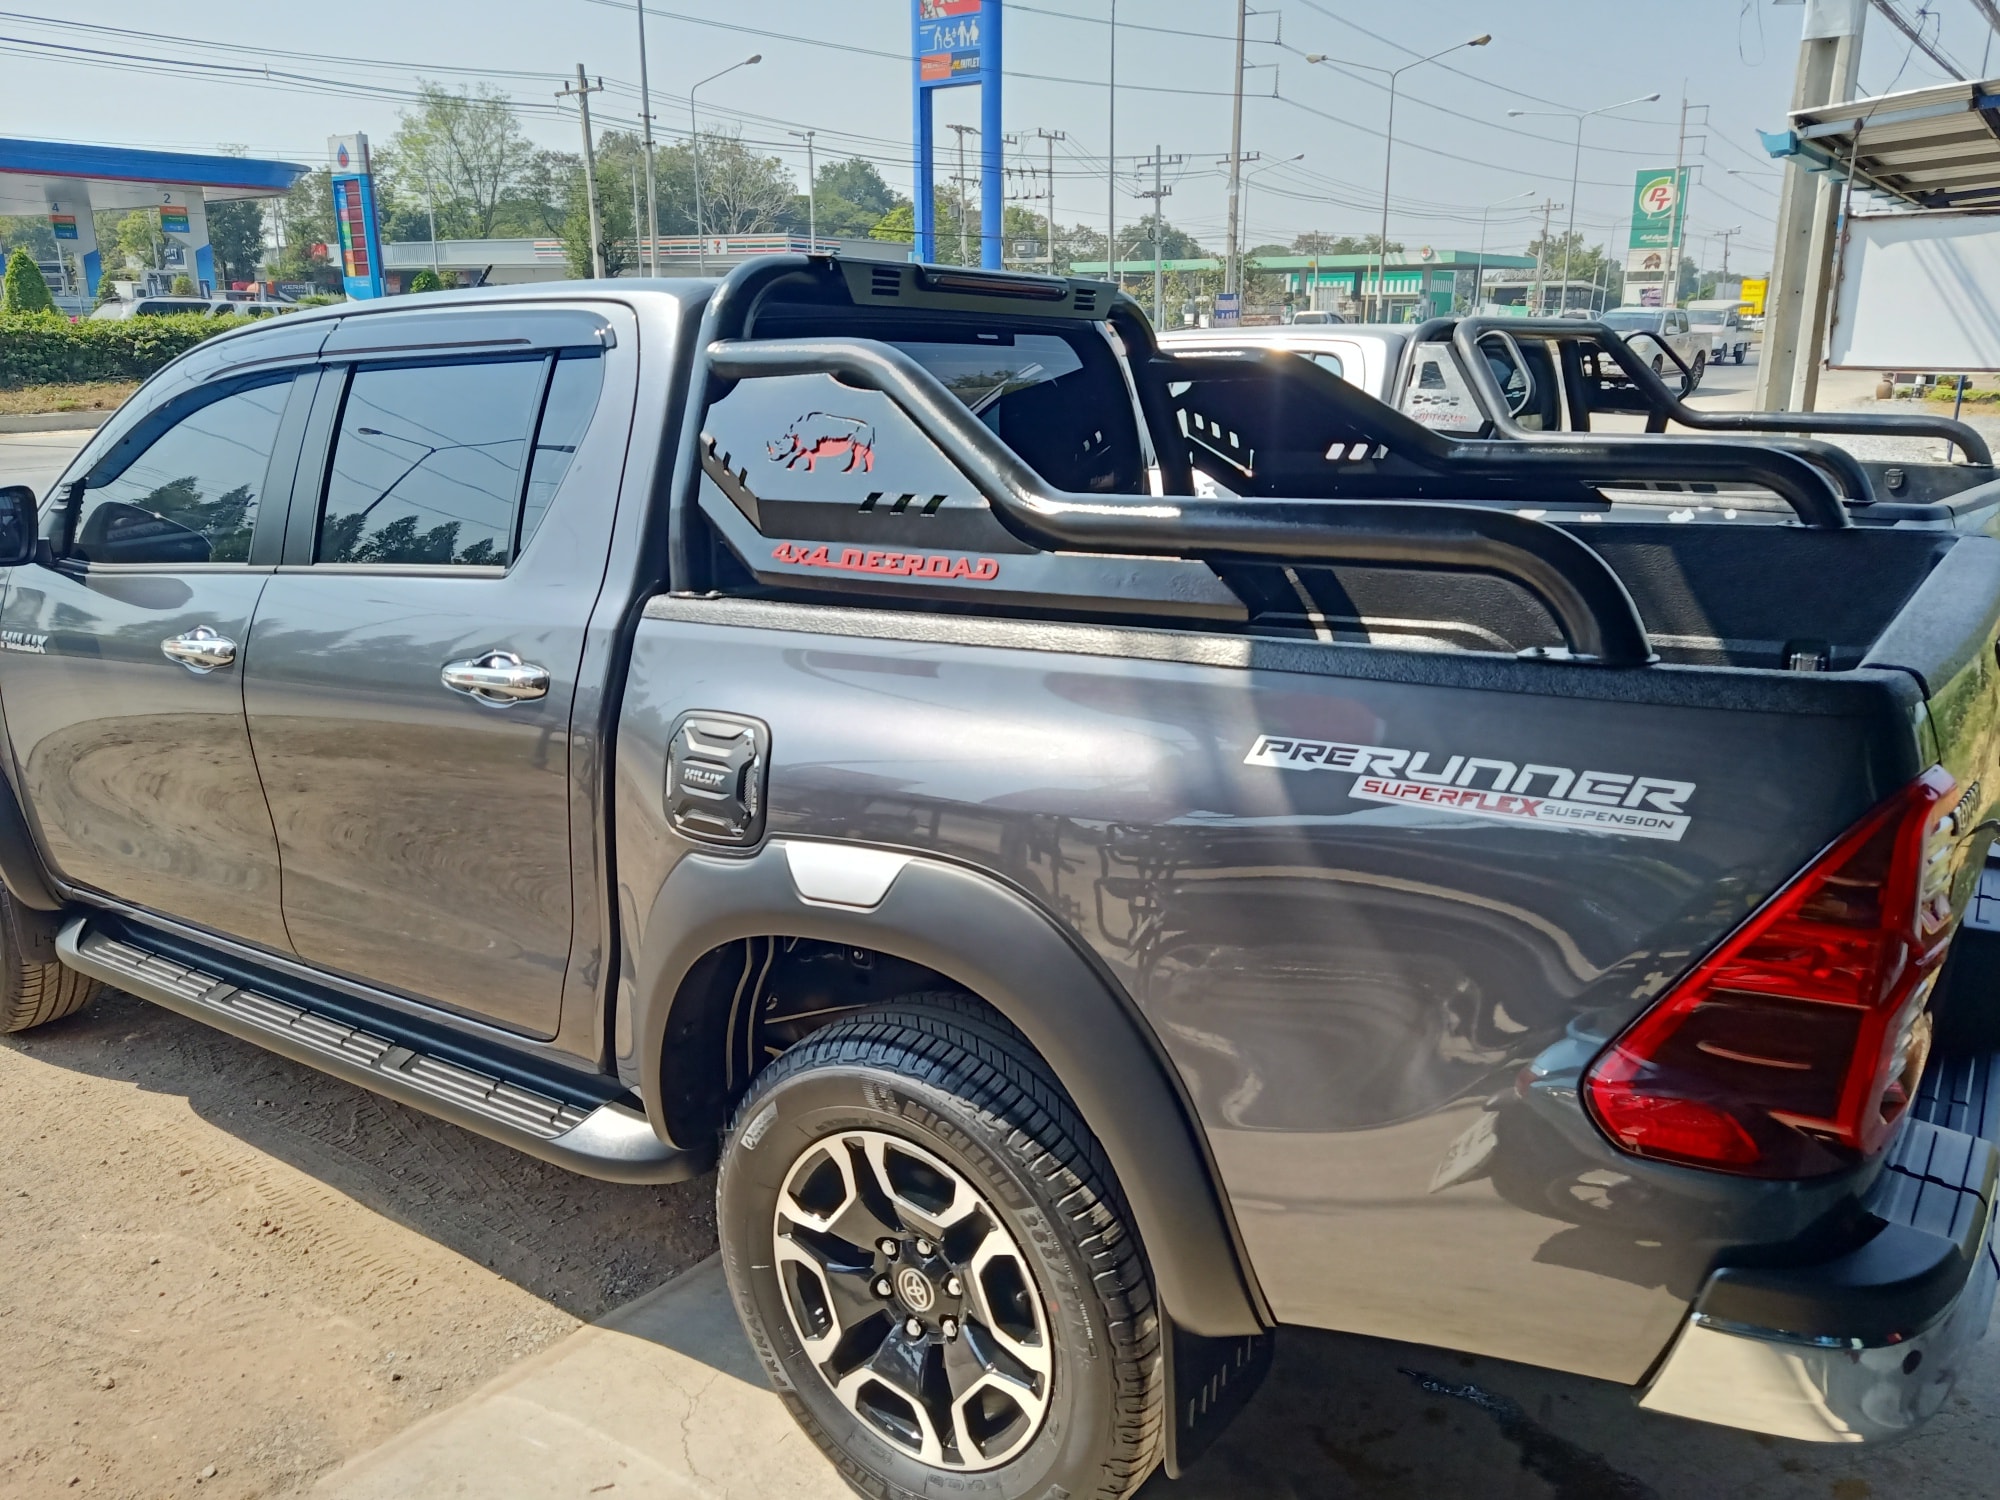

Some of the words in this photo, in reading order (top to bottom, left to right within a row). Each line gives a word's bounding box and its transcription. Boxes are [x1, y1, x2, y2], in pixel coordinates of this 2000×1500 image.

[52, 203, 59, 212] 4
[163, 193, 171, 204] 2
[771, 542, 830, 567] 4x4
[0, 630, 49, 654] HILUX
[683, 767, 726, 787] HILUX
[1250, 736, 1697, 814] PRERUNNER
[1360, 778, 1544, 818] SUPERFLEX
[1543, 804, 1676, 830] SUSPENSION
[902, 1100, 1023, 1204] MICHELIN
